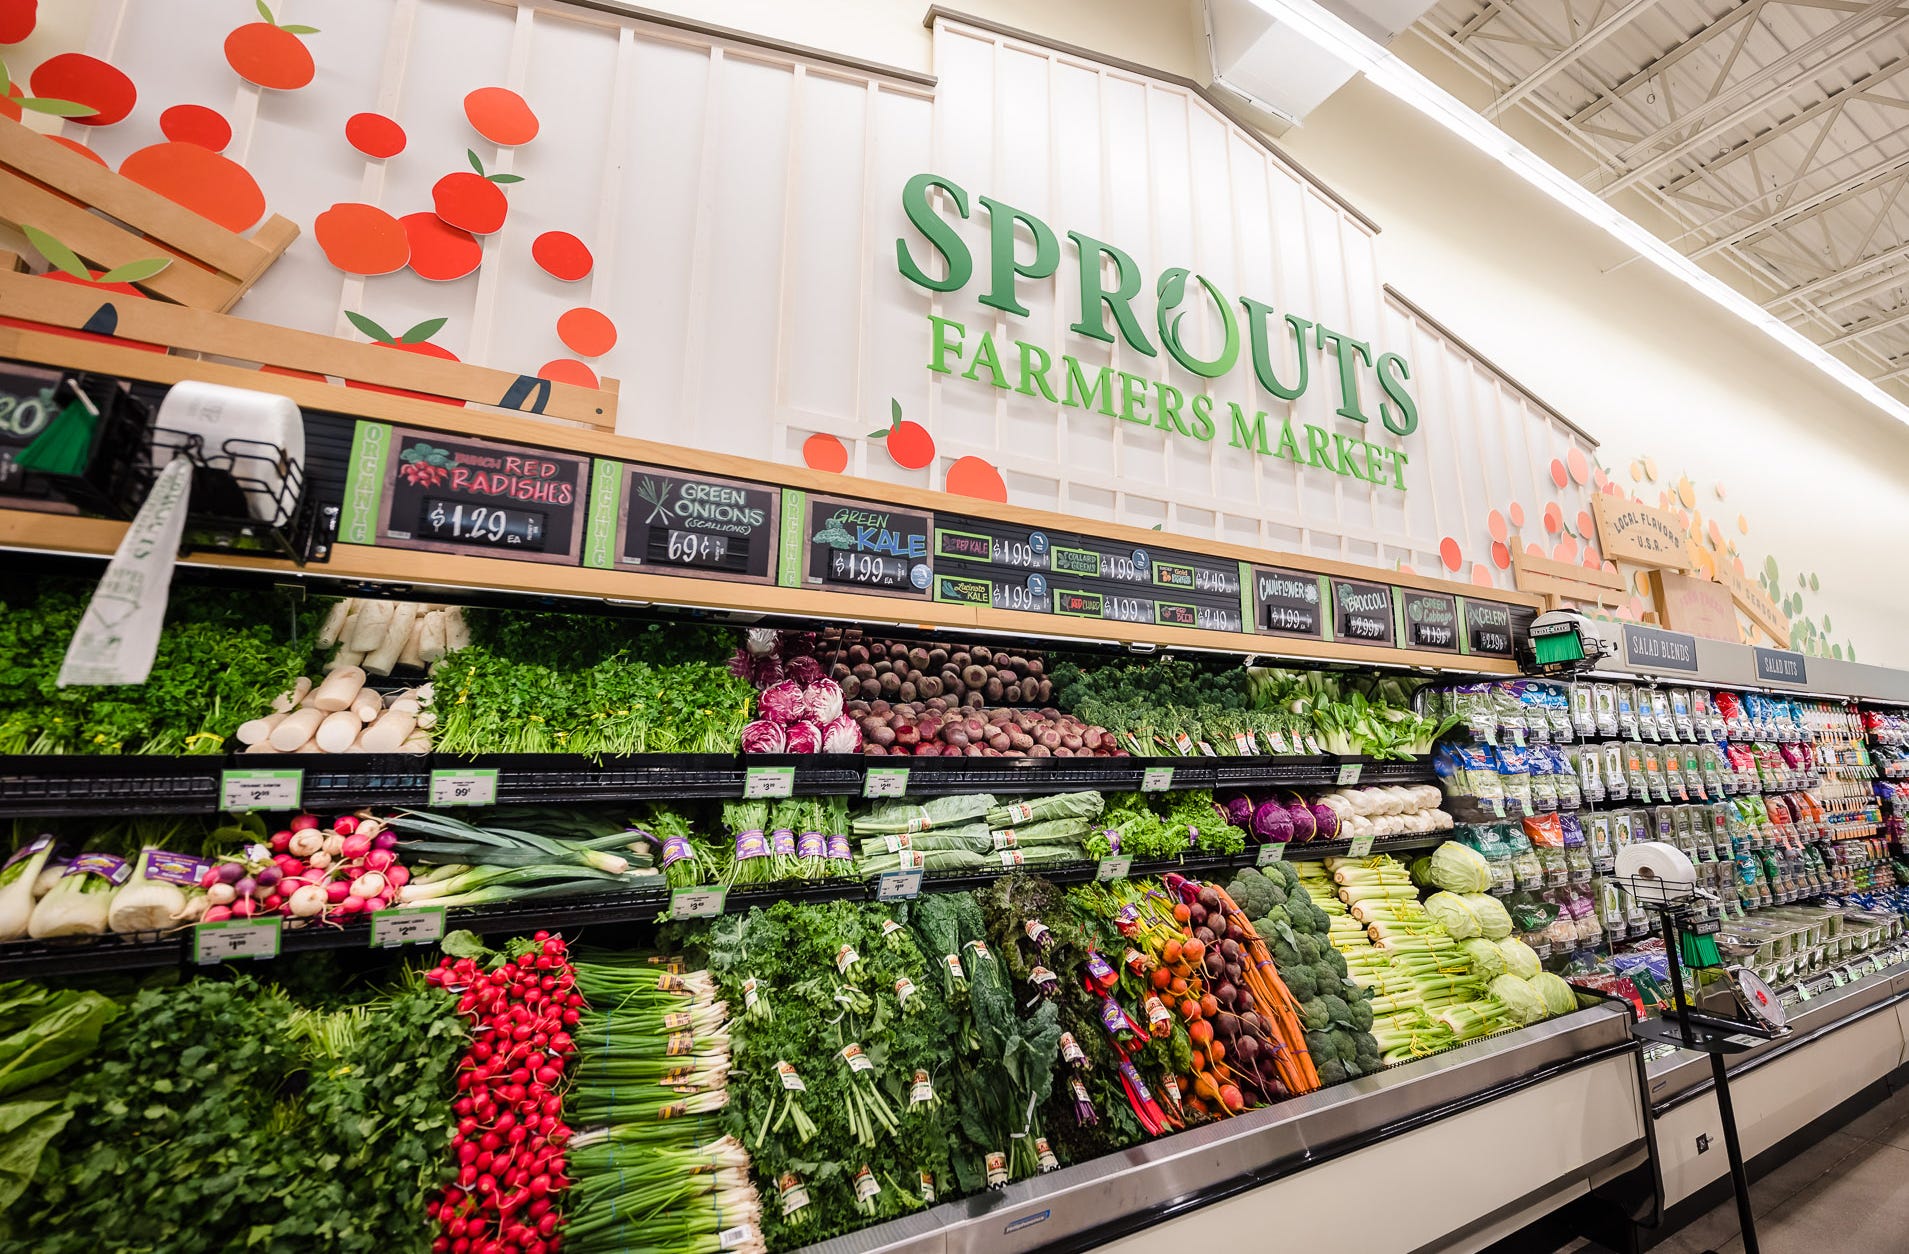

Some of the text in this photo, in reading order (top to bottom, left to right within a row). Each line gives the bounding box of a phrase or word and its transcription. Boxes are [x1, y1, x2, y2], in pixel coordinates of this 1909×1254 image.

[896, 173, 1418, 437] SPROUTS
[926, 314, 1409, 491] FARMERS MARKET
[505, 456, 557, 478] RED
[349, 423, 383, 543] ORGANIC
[452, 468, 572, 505] RADISHES
[680, 483, 745, 505] GREEN
[430, 503, 507, 542] $1.29
[592, 462, 615, 566] ORGANIC
[674, 499, 765, 526] ONIONS
[833, 508, 890, 528] GREEN
[684, 518, 752, 535] (SCALLIONS)
[1613, 512, 1680, 548] LOCAL FLAVORS
[668, 532, 710, 562] 69¢
[856, 525, 927, 558] KALE
[970, 539, 988, 554] KALE
[993, 539, 1032, 567] $1.99
[835, 553, 884, 583] $1.99
[1101, 557, 1135, 581] $1.99
[967, 591, 988, 602] KALE
[993, 584, 1032, 610] $1.99
[1105, 597, 1138, 621] $1.99
[1348, 592, 1387, 613] BROCCOLI
[1479, 607, 1506, 627] CELERY
[1632, 635, 1690, 662] SALAD BLENDS
[1764, 657, 1798, 677] SALAD KITS
